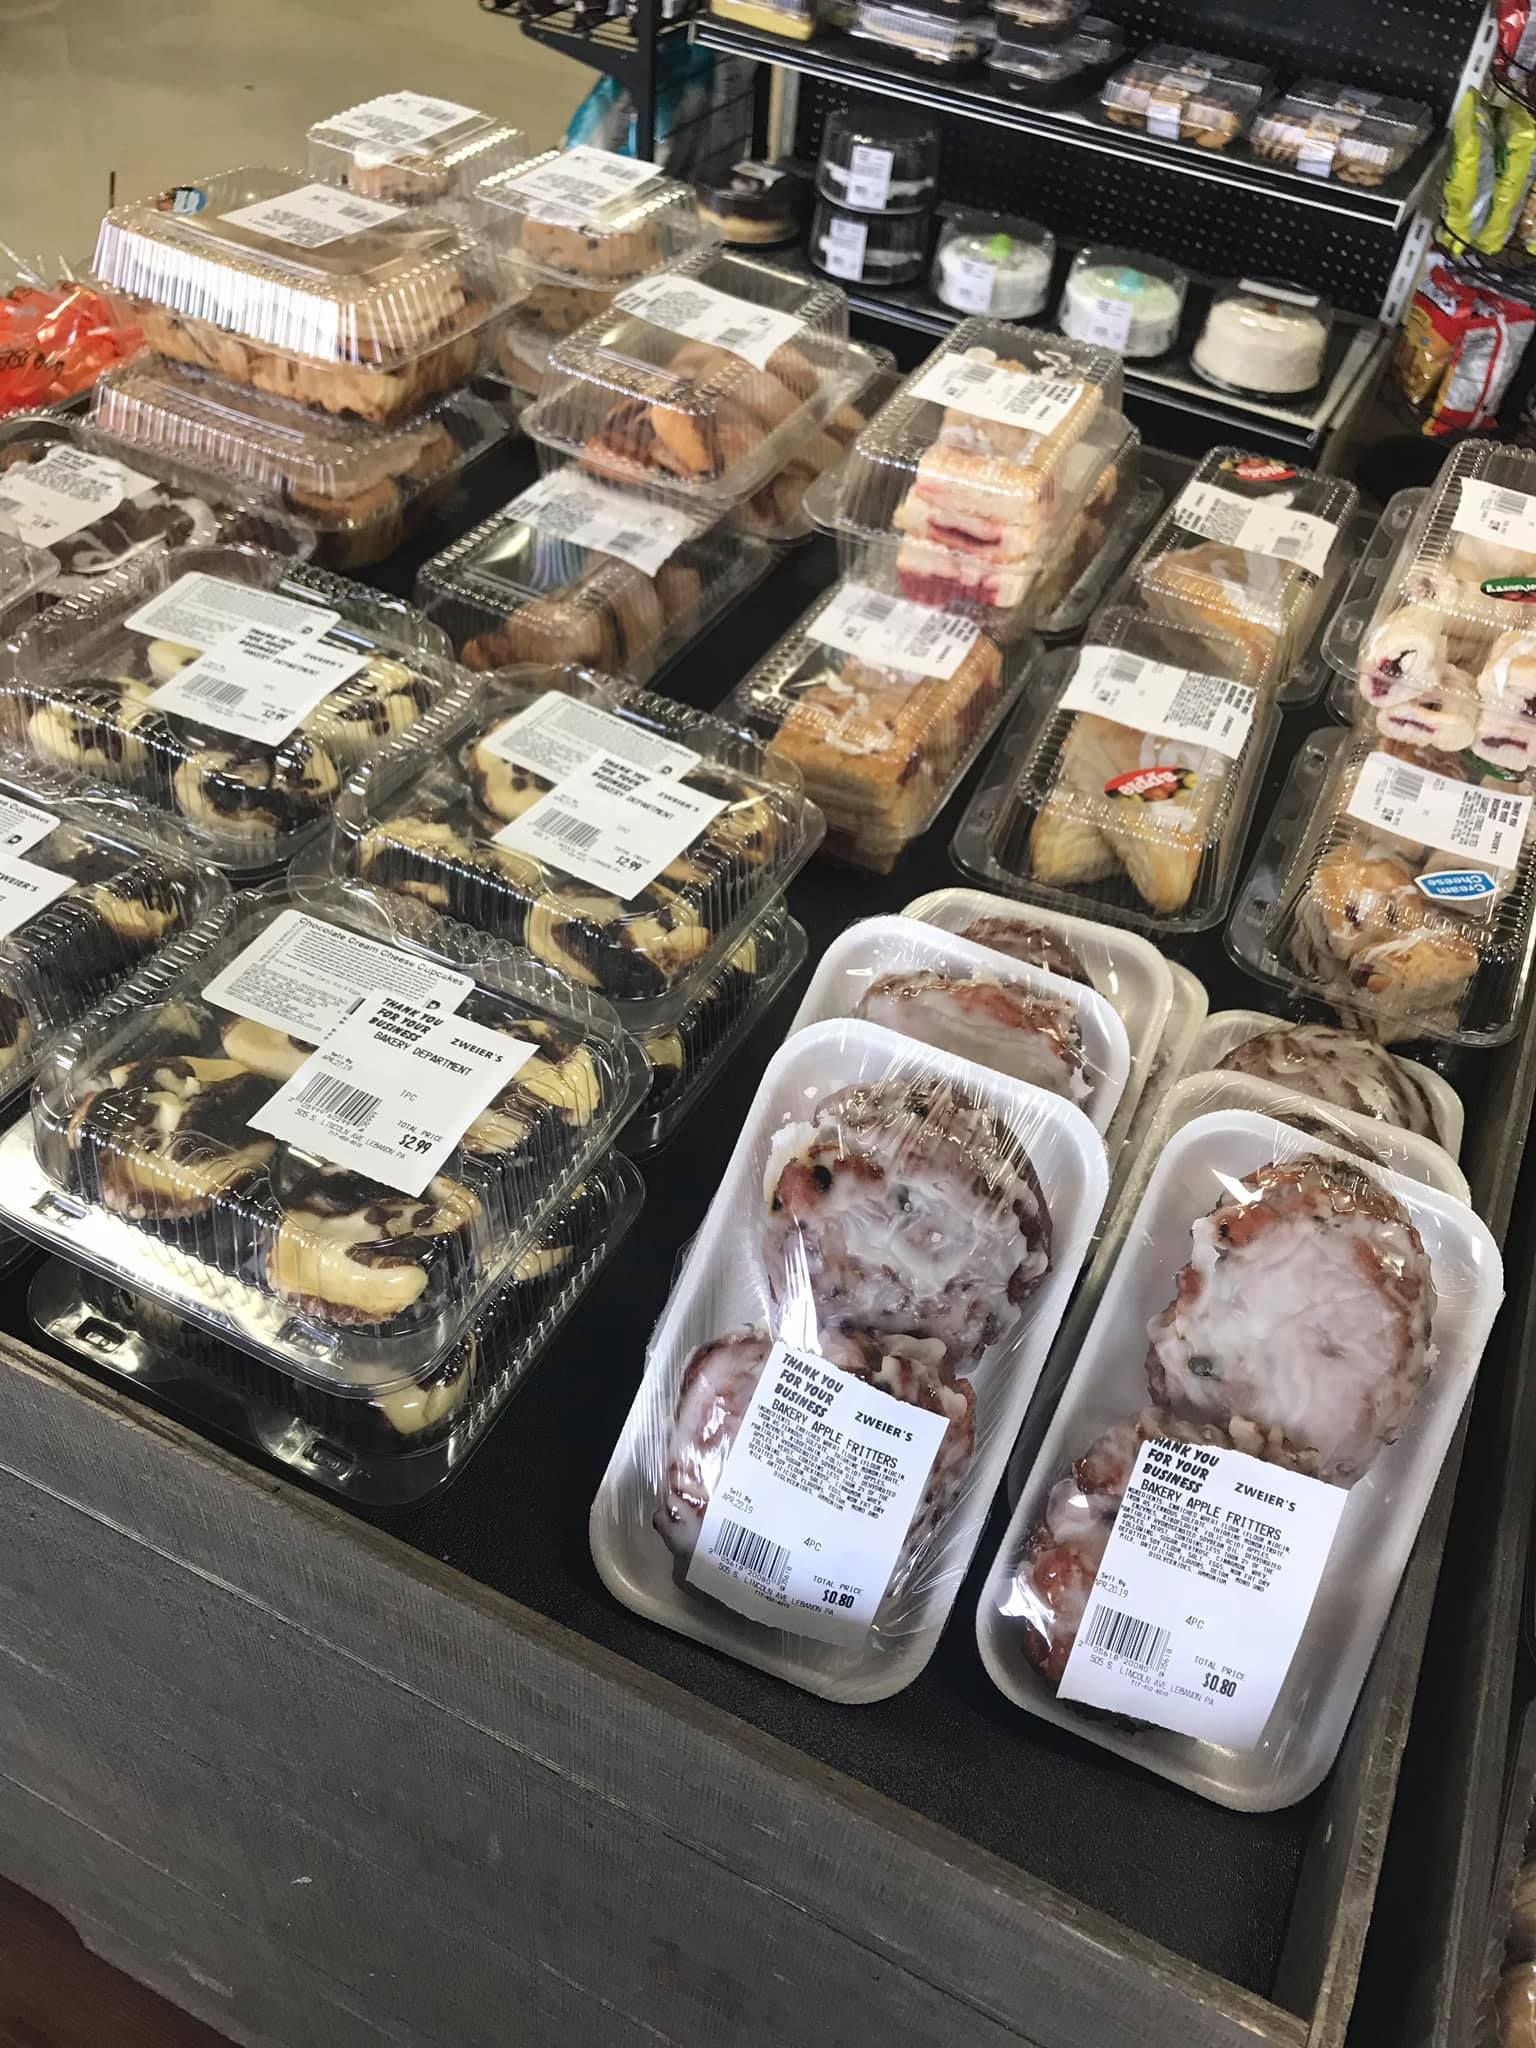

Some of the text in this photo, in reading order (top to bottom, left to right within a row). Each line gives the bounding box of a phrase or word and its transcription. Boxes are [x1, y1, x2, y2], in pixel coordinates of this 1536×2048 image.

[626, 796, 674, 819] DEPARTMENT
[1427, 875, 1482, 886] Cheese
[1436, 883, 1486, 894] Cream
[299, 917, 465, 987] Chocolate Cream Cheese Cupcakes
[377, 1008, 431, 1034] FOR YOUR
[382, 998, 444, 1026] THANK YOU
[368, 1017, 422, 1041] BUSINESS
[374, 1031, 472, 1076] BAKERY DEPARTMENT
[450, 1038, 503, 1062] ZWEIER'S
[320, 1120, 351, 1135] LINCOLN
[350, 1133, 365, 1142] AVE
[365, 1139, 395, 1155] LEBANON
[398, 1120, 444, 1142] TOTAL PRICE
[399, 1134, 432, 1154] $2.99
[782, 1353, 844, 1393] THANK YOU
[775, 1383, 828, 1417] BUSINESS
[780, 1369, 834, 1406] FOR YOUR
[772, 1398, 898, 1468] BAKERY APPLE FRITTERS
[855, 1411, 912, 1442] ZWEIER'S
[1148, 1448, 1209, 1480] FOR YOUR
[1194, 1450, 1220, 1466] YOU
[1142, 1463, 1202, 1493] BUSINESS
[1141, 1478, 1281, 1540] BAKERY APPLE FRITTERS
[1234, 1482, 1296, 1512] ZWEIER'S
[804, 1537, 821, 1552] 4PC
[814, 1576, 861, 1595] TOTAL PRICE
[1100, 1572, 1115, 1585] Sell
[742, 1576, 773, 1597] LINCOLN
[774, 1592, 787, 1603] AVE
[791, 1598, 822, 1614] LEBANON
[823, 1608, 833, 1617] PA
[822, 1590, 854, 1608] $0.80
[1186, 1616, 1204, 1629] 4PC
[1195, 1656, 1246, 1680] TOTAL PRICE
[1120, 1666, 1151, 1684] LINCOLN
[1154, 1680, 1166, 1690] AVE
[1170, 1686, 1202, 1701] LEBANON
[1204, 1696, 1214, 1706] PA
[1203, 1672, 1237, 1697] $0.80
